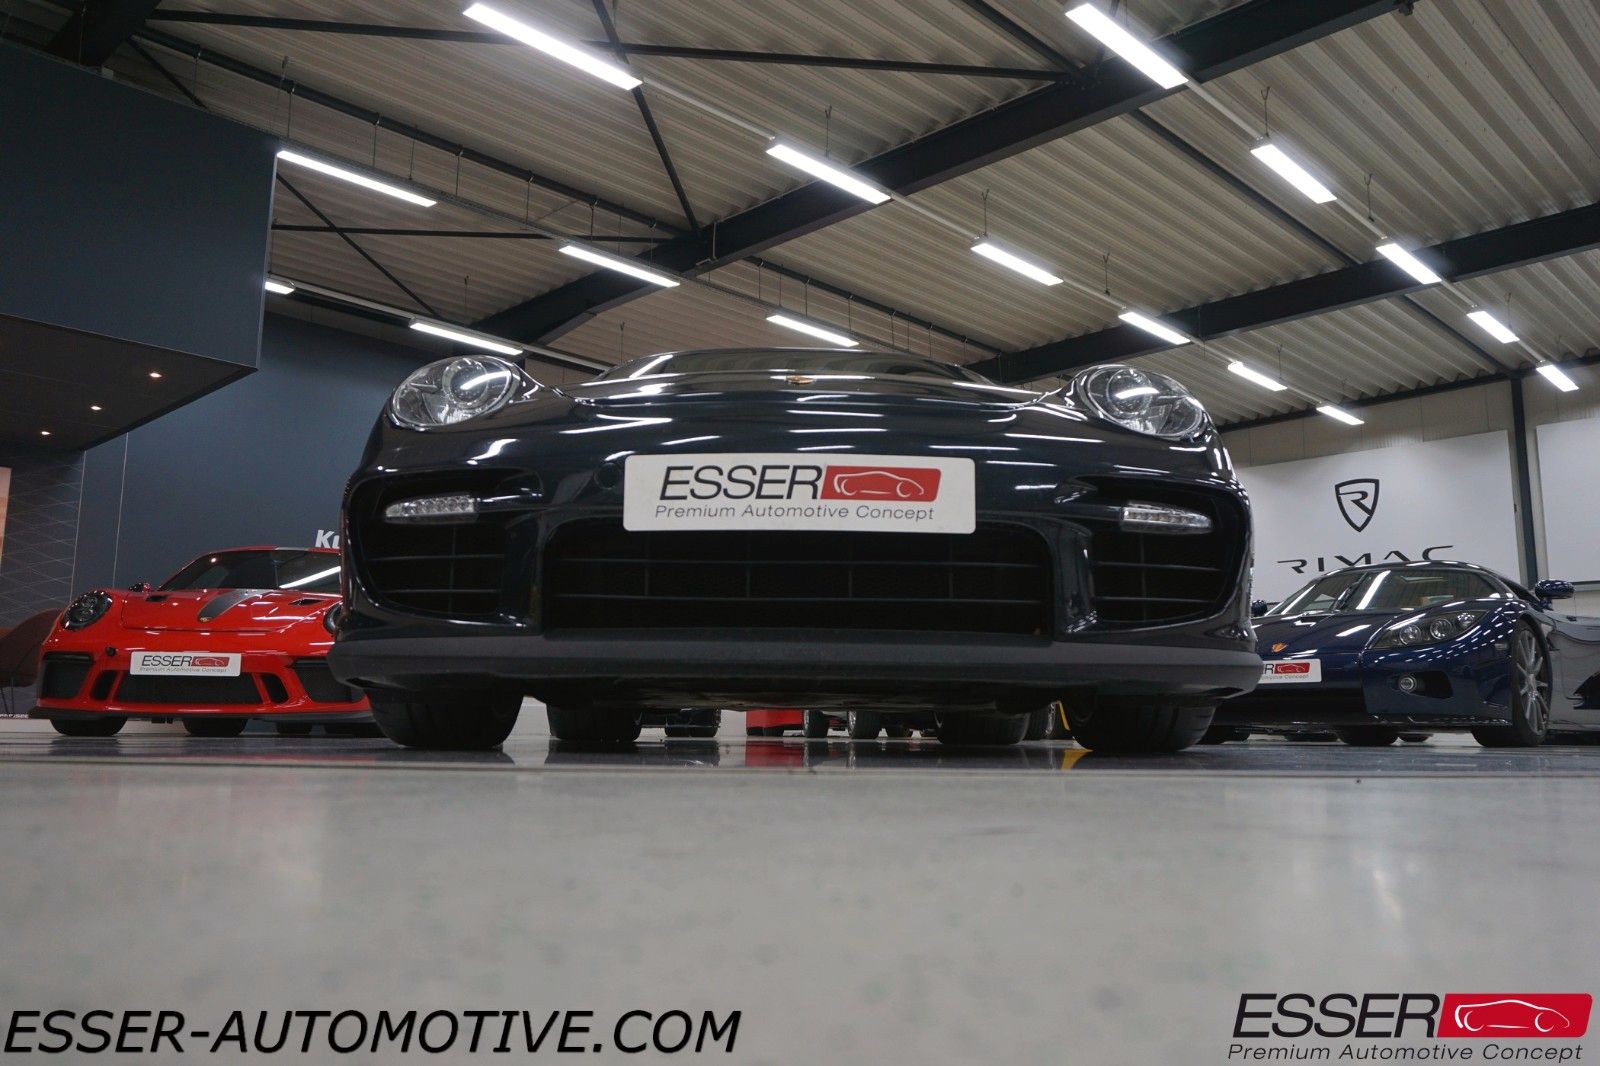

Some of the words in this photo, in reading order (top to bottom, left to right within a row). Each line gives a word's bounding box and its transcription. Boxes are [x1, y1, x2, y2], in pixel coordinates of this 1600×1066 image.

[660, 464, 823, 500] ESSER
[655, 504, 736, 519] Premium
[741, 504, 849, 519] Automotive
[855, 505, 935, 522] Concept
[141, 655, 192, 666] ESSER
